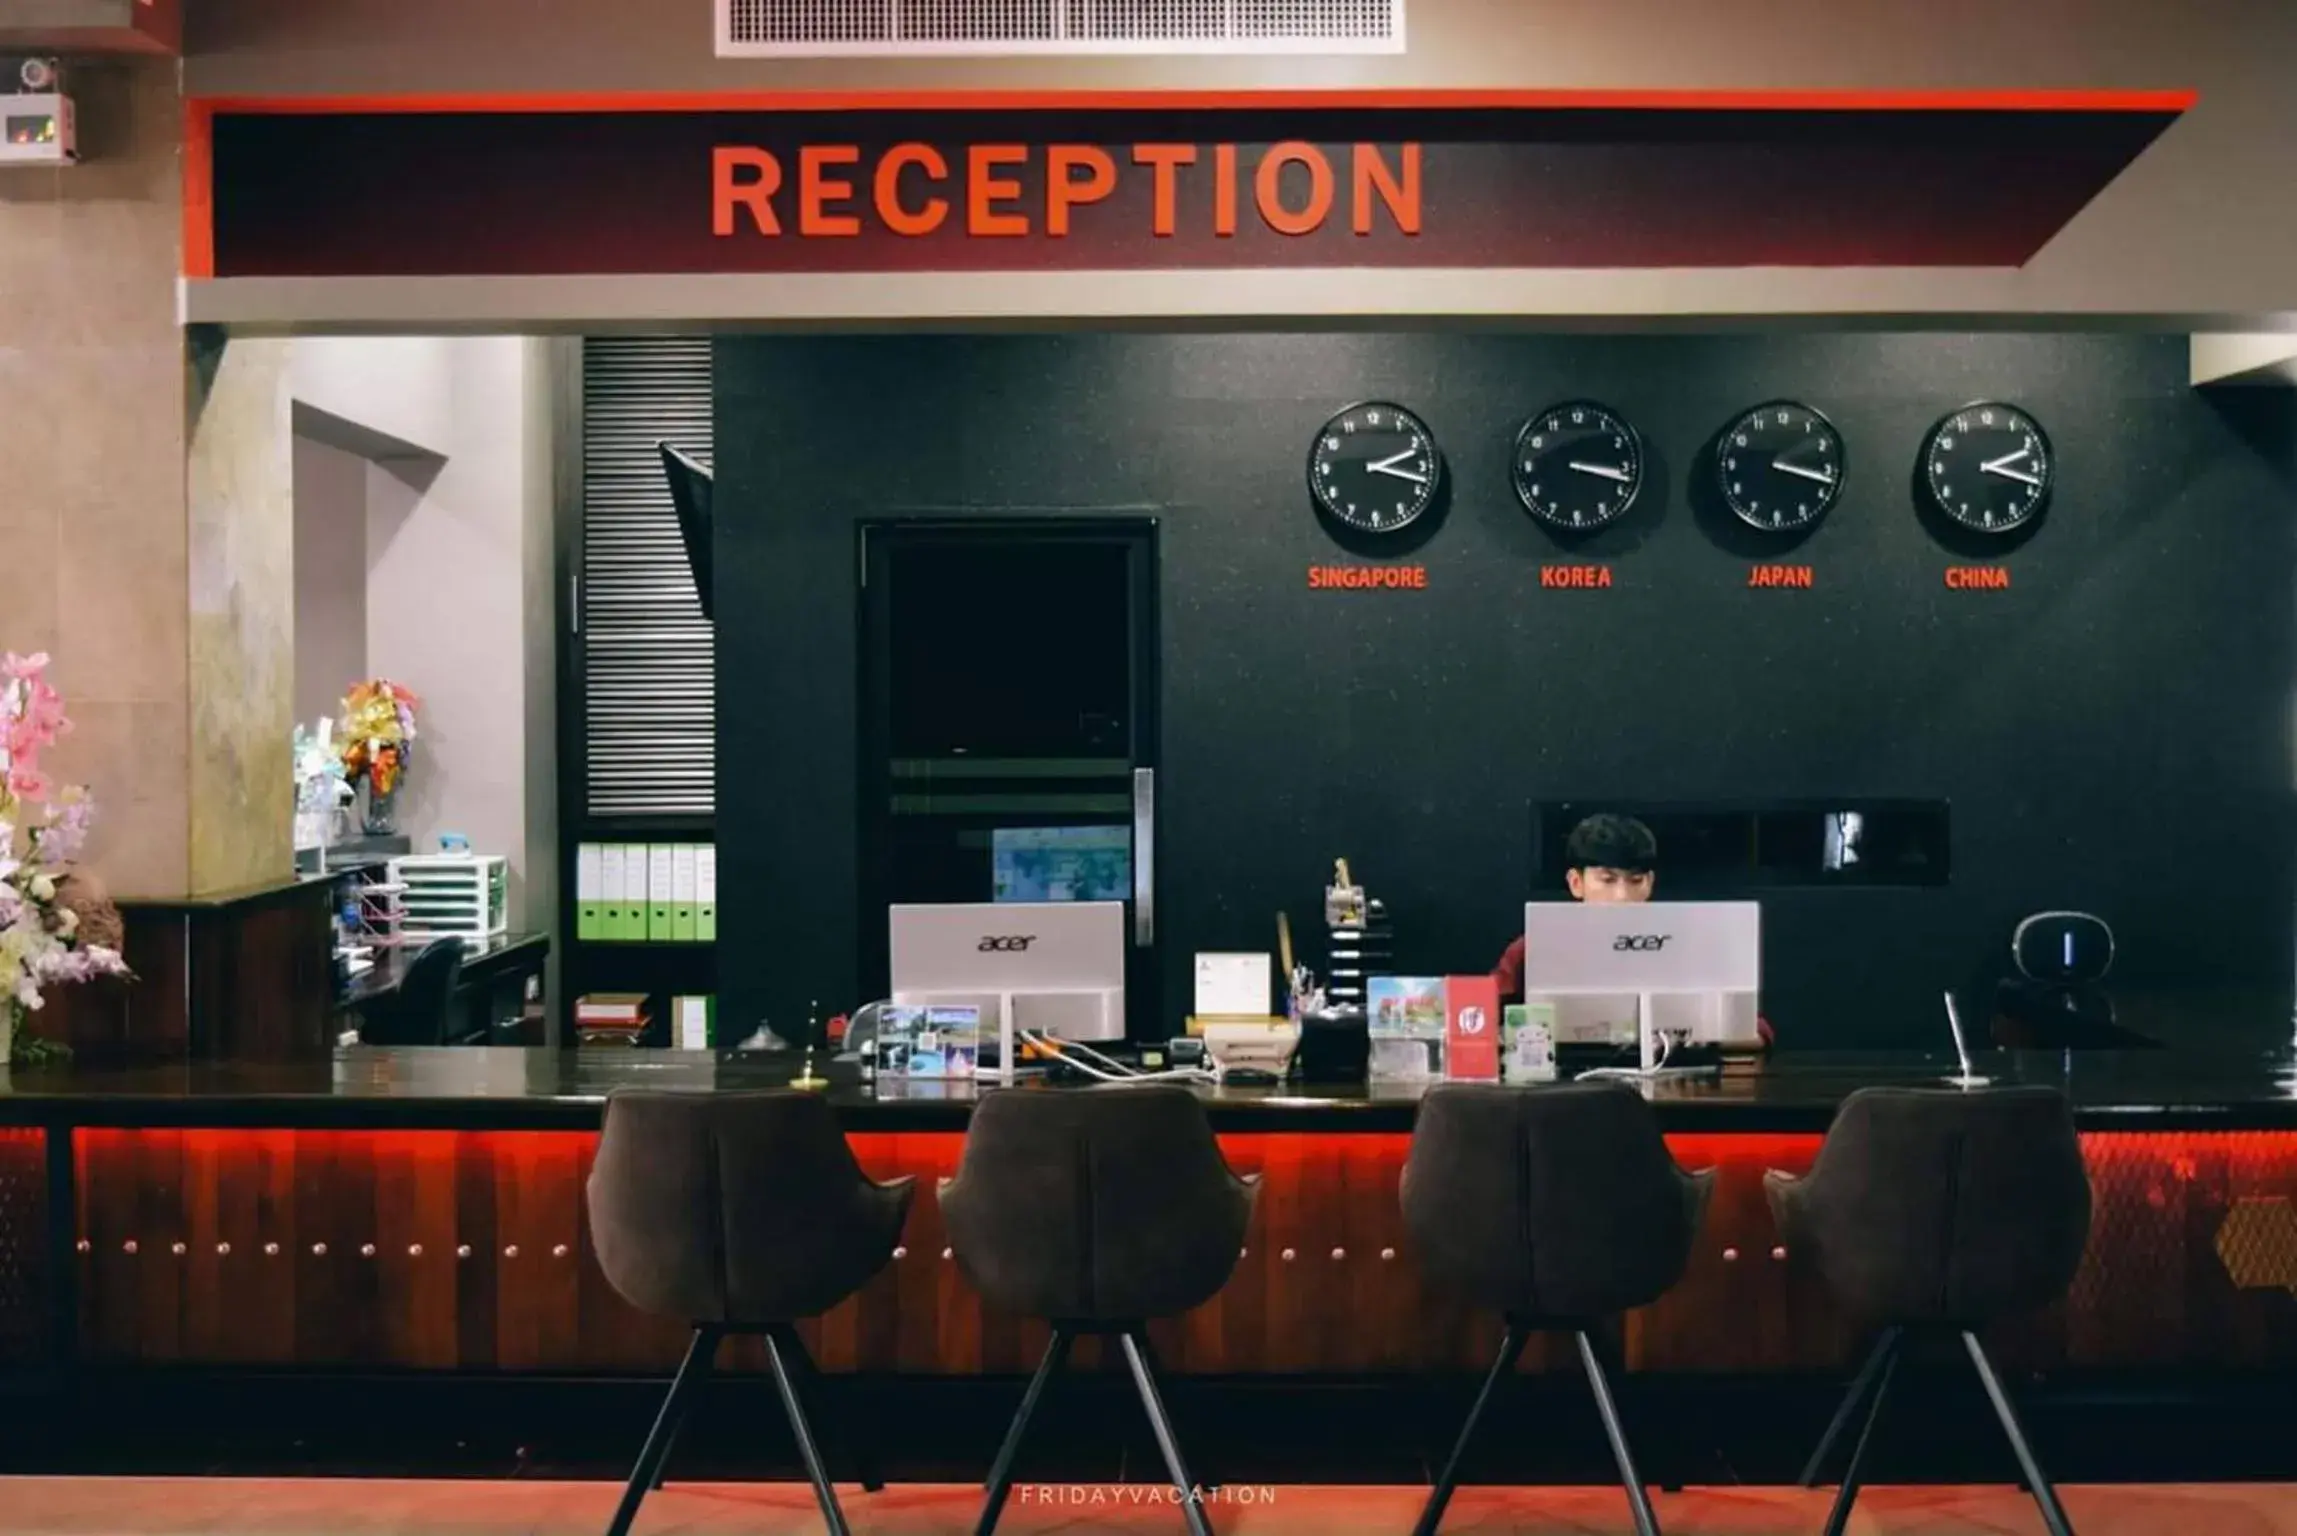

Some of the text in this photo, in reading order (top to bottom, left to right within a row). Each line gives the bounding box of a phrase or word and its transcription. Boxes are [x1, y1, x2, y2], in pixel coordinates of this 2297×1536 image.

[712, 140, 1422, 237] RECEPTION
[1308, 565, 1427, 590] SINGAPORE
[1541, 566, 1612, 589] KOREA
[1749, 566, 1813, 588] JAPAN
[1945, 567, 2009, 590] CHINA
[977, 934, 1037, 953] acer
[1613, 935, 1671, 951] acer
